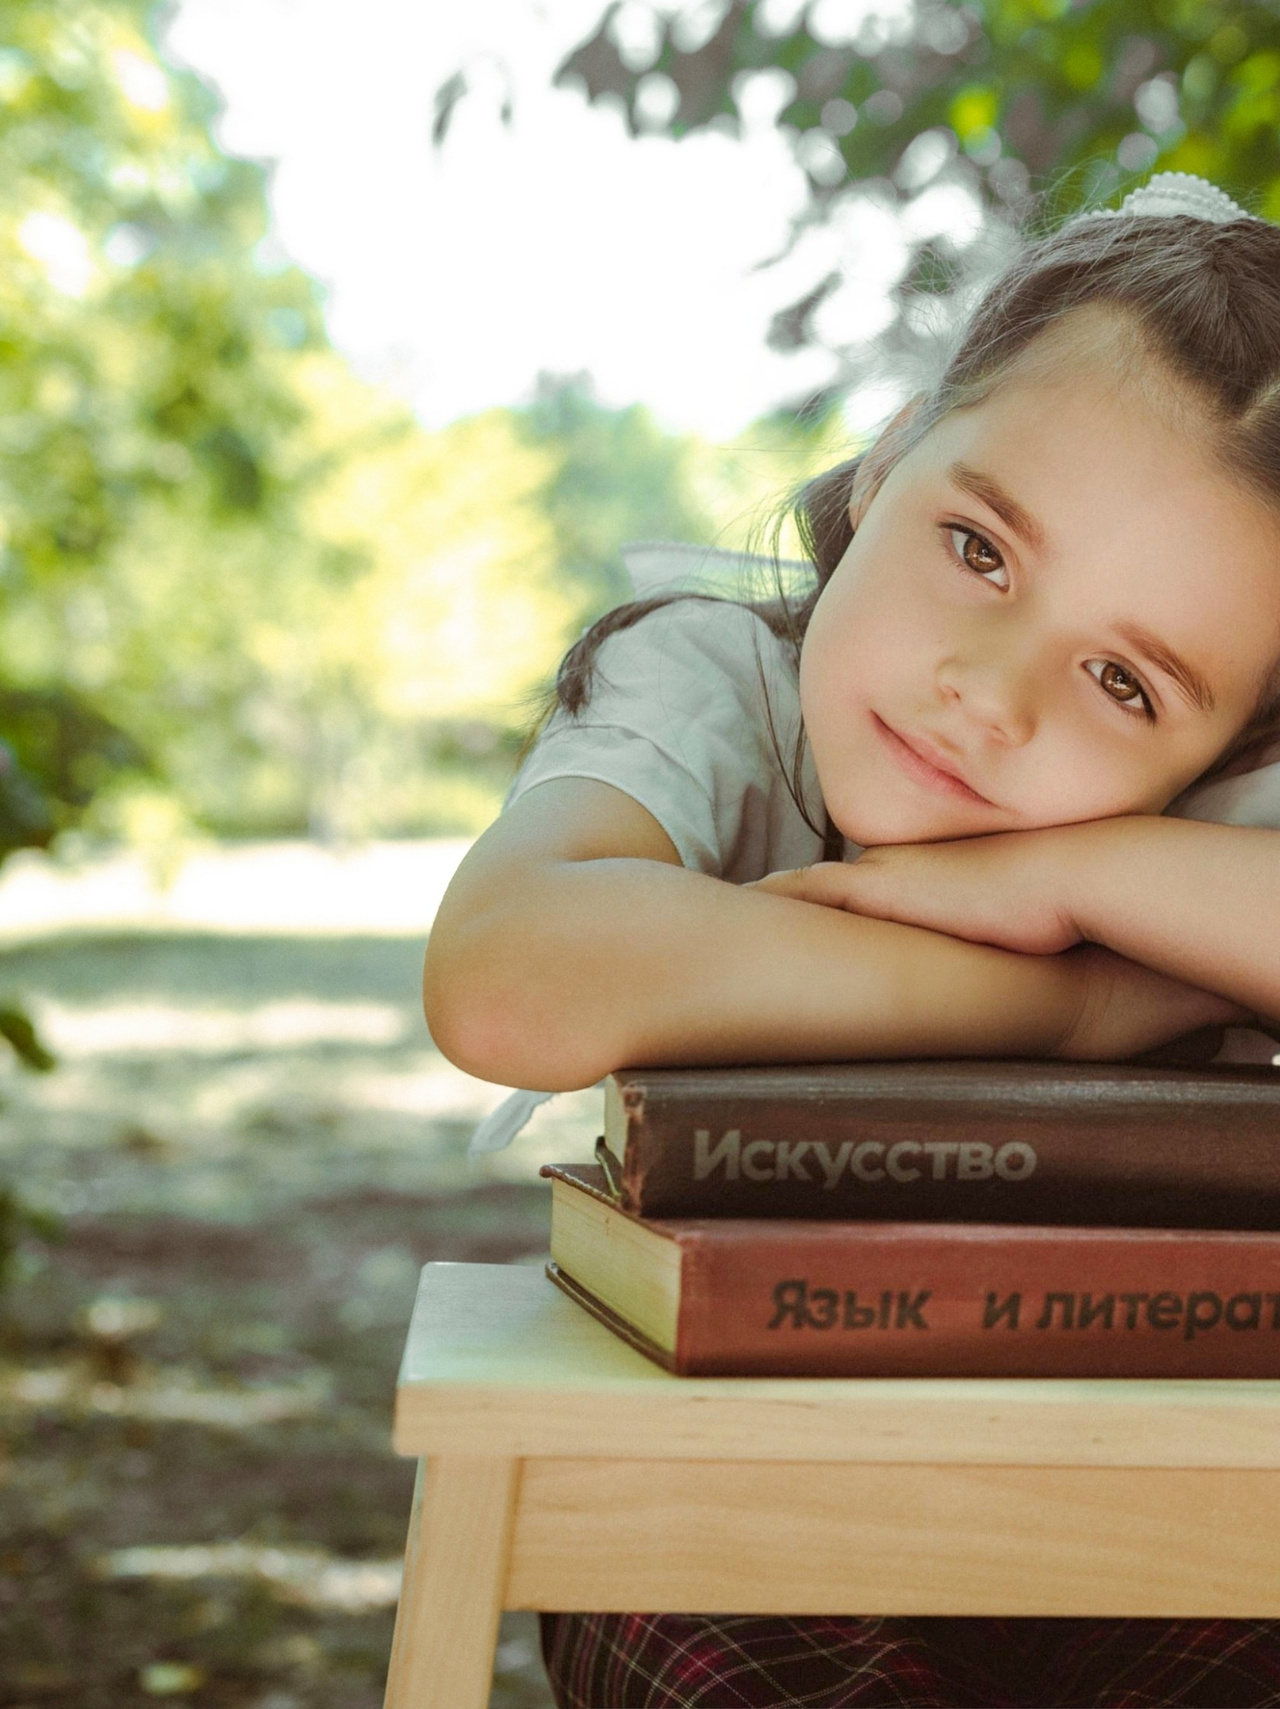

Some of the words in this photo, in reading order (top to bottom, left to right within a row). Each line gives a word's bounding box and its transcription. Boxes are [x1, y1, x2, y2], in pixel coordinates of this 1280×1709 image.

[693, 1129, 1037, 1189] Искусство
[767, 1278, 932, 1331] Язык
[982, 1291, 1022, 1331] и
